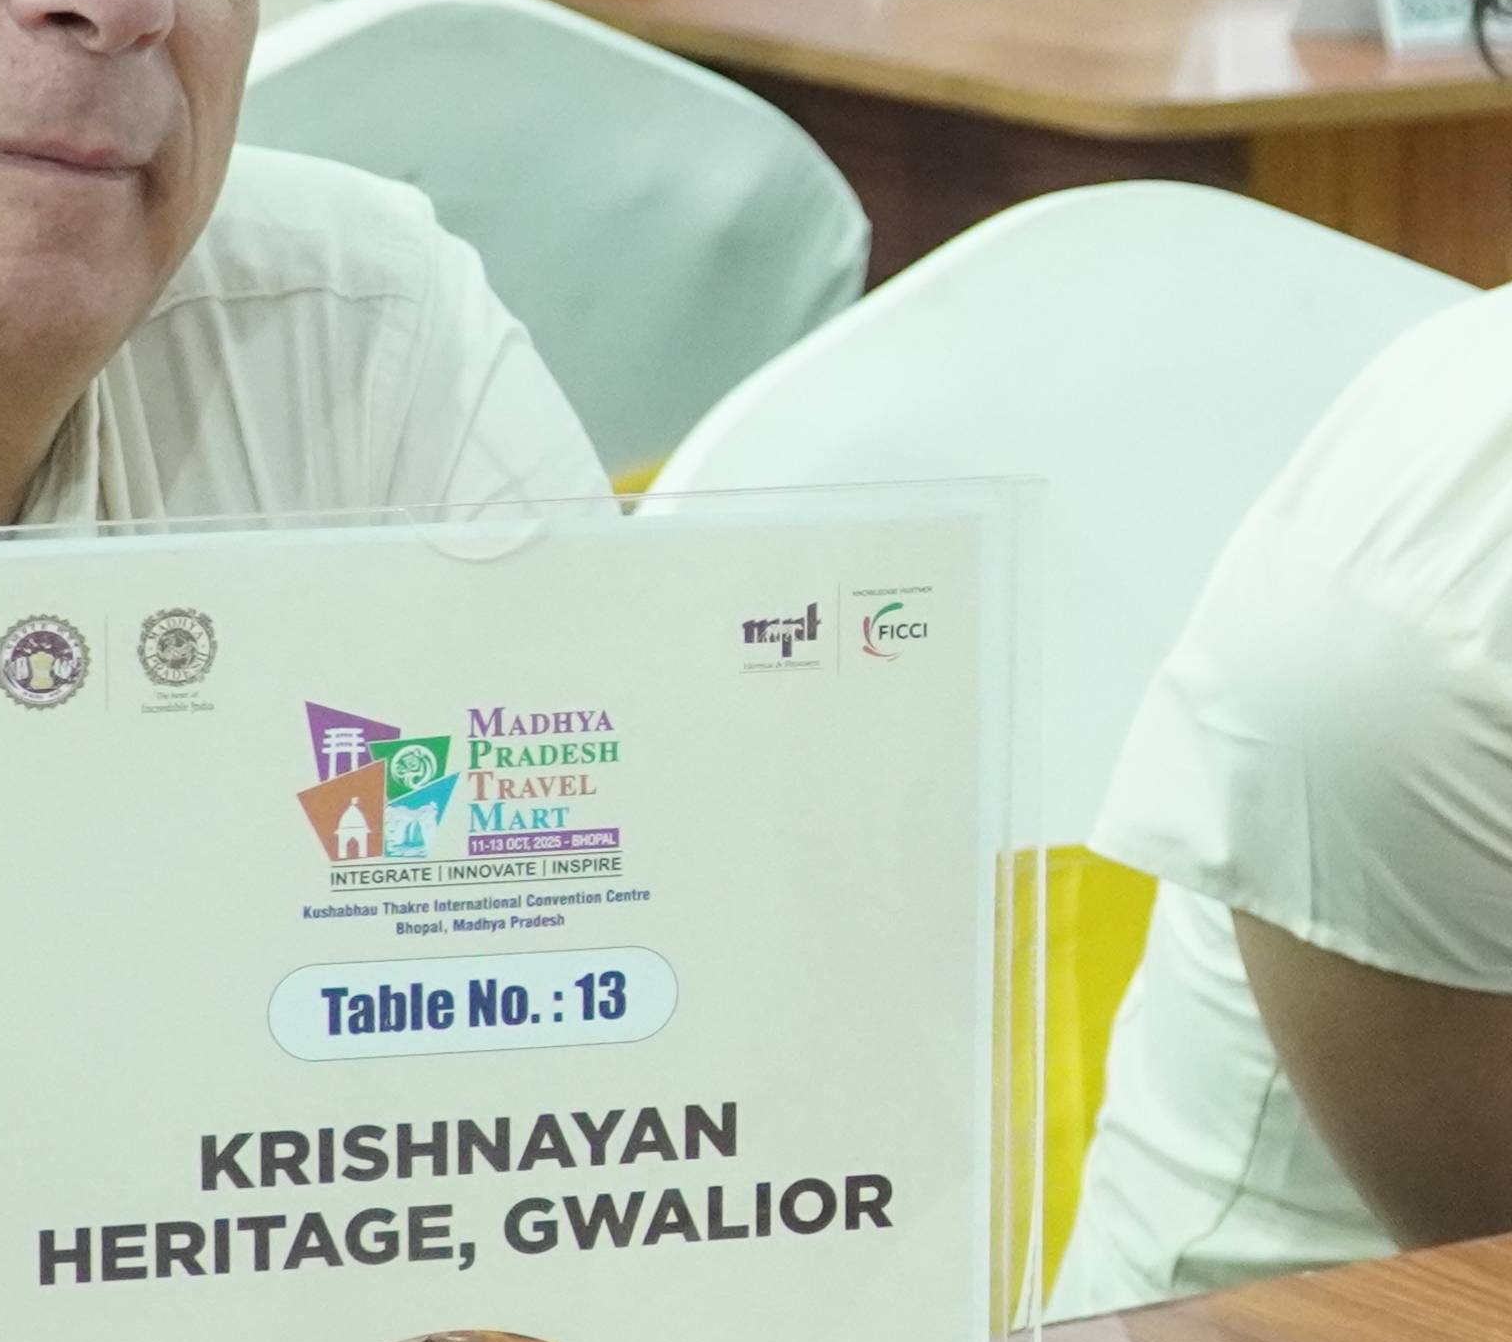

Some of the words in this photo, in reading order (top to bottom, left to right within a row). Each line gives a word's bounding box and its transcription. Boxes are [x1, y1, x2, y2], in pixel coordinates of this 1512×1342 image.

[879, 623, 928, 641] FICCI
[467, 706, 615, 738] MADHYA
[468, 739, 620, 770] PRADESH
[468, 771, 598, 802] TRAVEL
[468, 802, 570, 833] MART
[571, 833, 617, 848] BHOPAL
[330, 866, 433, 886] INTEGRATE
[448, 862, 537, 881] INNOVATE
[552, 857, 623, 875] INSPIRE
[302, 903, 378, 921] Kushabhau
[382, 900, 430, 916] Thakre
[434, 896, 522, 914] International
[526, 892, 603, 909] Convention
[606, 888, 651, 904] Centre
[396, 921, 449, 937] Bhopal,
[452, 917, 507, 934] Madhya
[510, 913, 565, 930] Pradesh
[321, 979, 455, 1037] Table
[468, 974, 541, 1030] No.
[575, 970, 628, 1022] 13
[201, 1101, 739, 1192] KRISHNAYAN
[38, 1203, 478, 1287] HERITAGE,
[504, 1173, 895, 1257] GWALIOR
